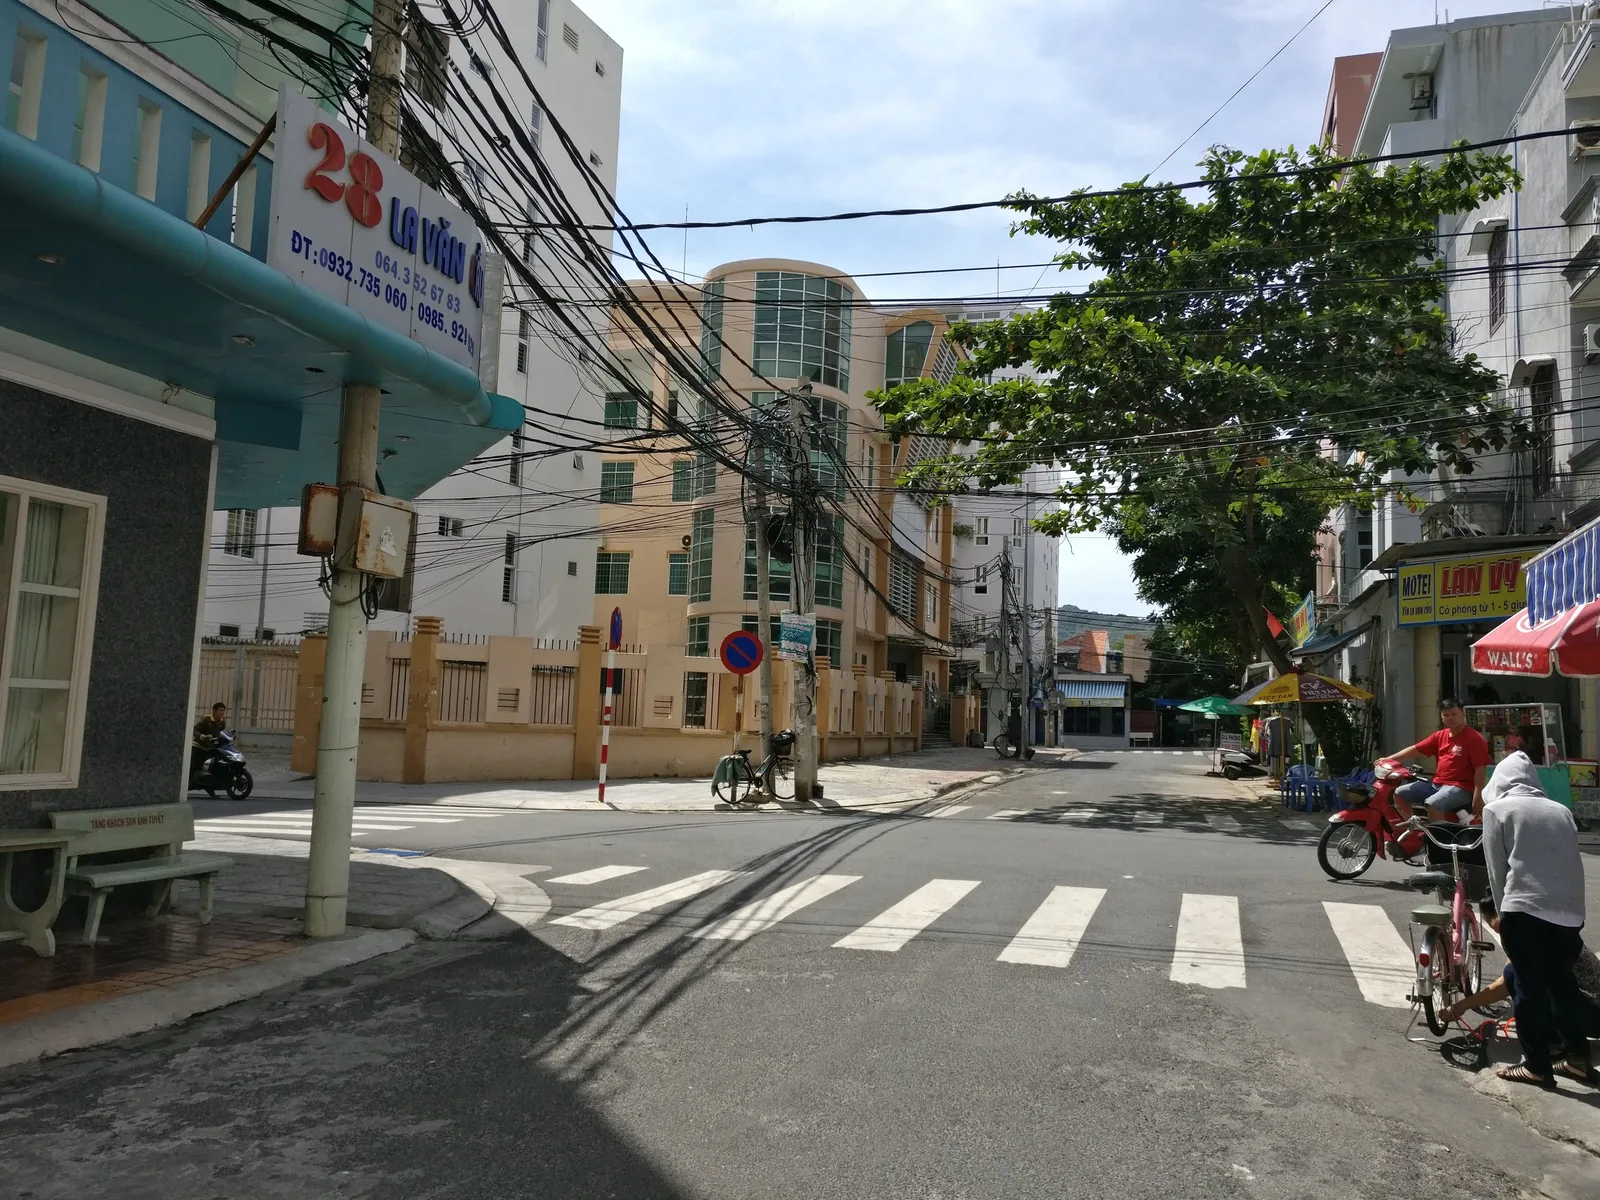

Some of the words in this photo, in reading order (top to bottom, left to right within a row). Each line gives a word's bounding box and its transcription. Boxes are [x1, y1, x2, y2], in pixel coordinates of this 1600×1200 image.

[305, 122, 384, 228] 28
[390, 196, 418, 255] LA
[422, 216, 466, 285] VĂN
[385, 283, 407, 312] 060
[429, 284, 445, 304] 67
[446, 293, 461, 314] 83
[1441, 562, 1484, 598] LAN
[1489, 556, 1522, 594] VY
[1503, 600, 1509, 611] 5
[1487, 651, 1534, 669] WALL'S
